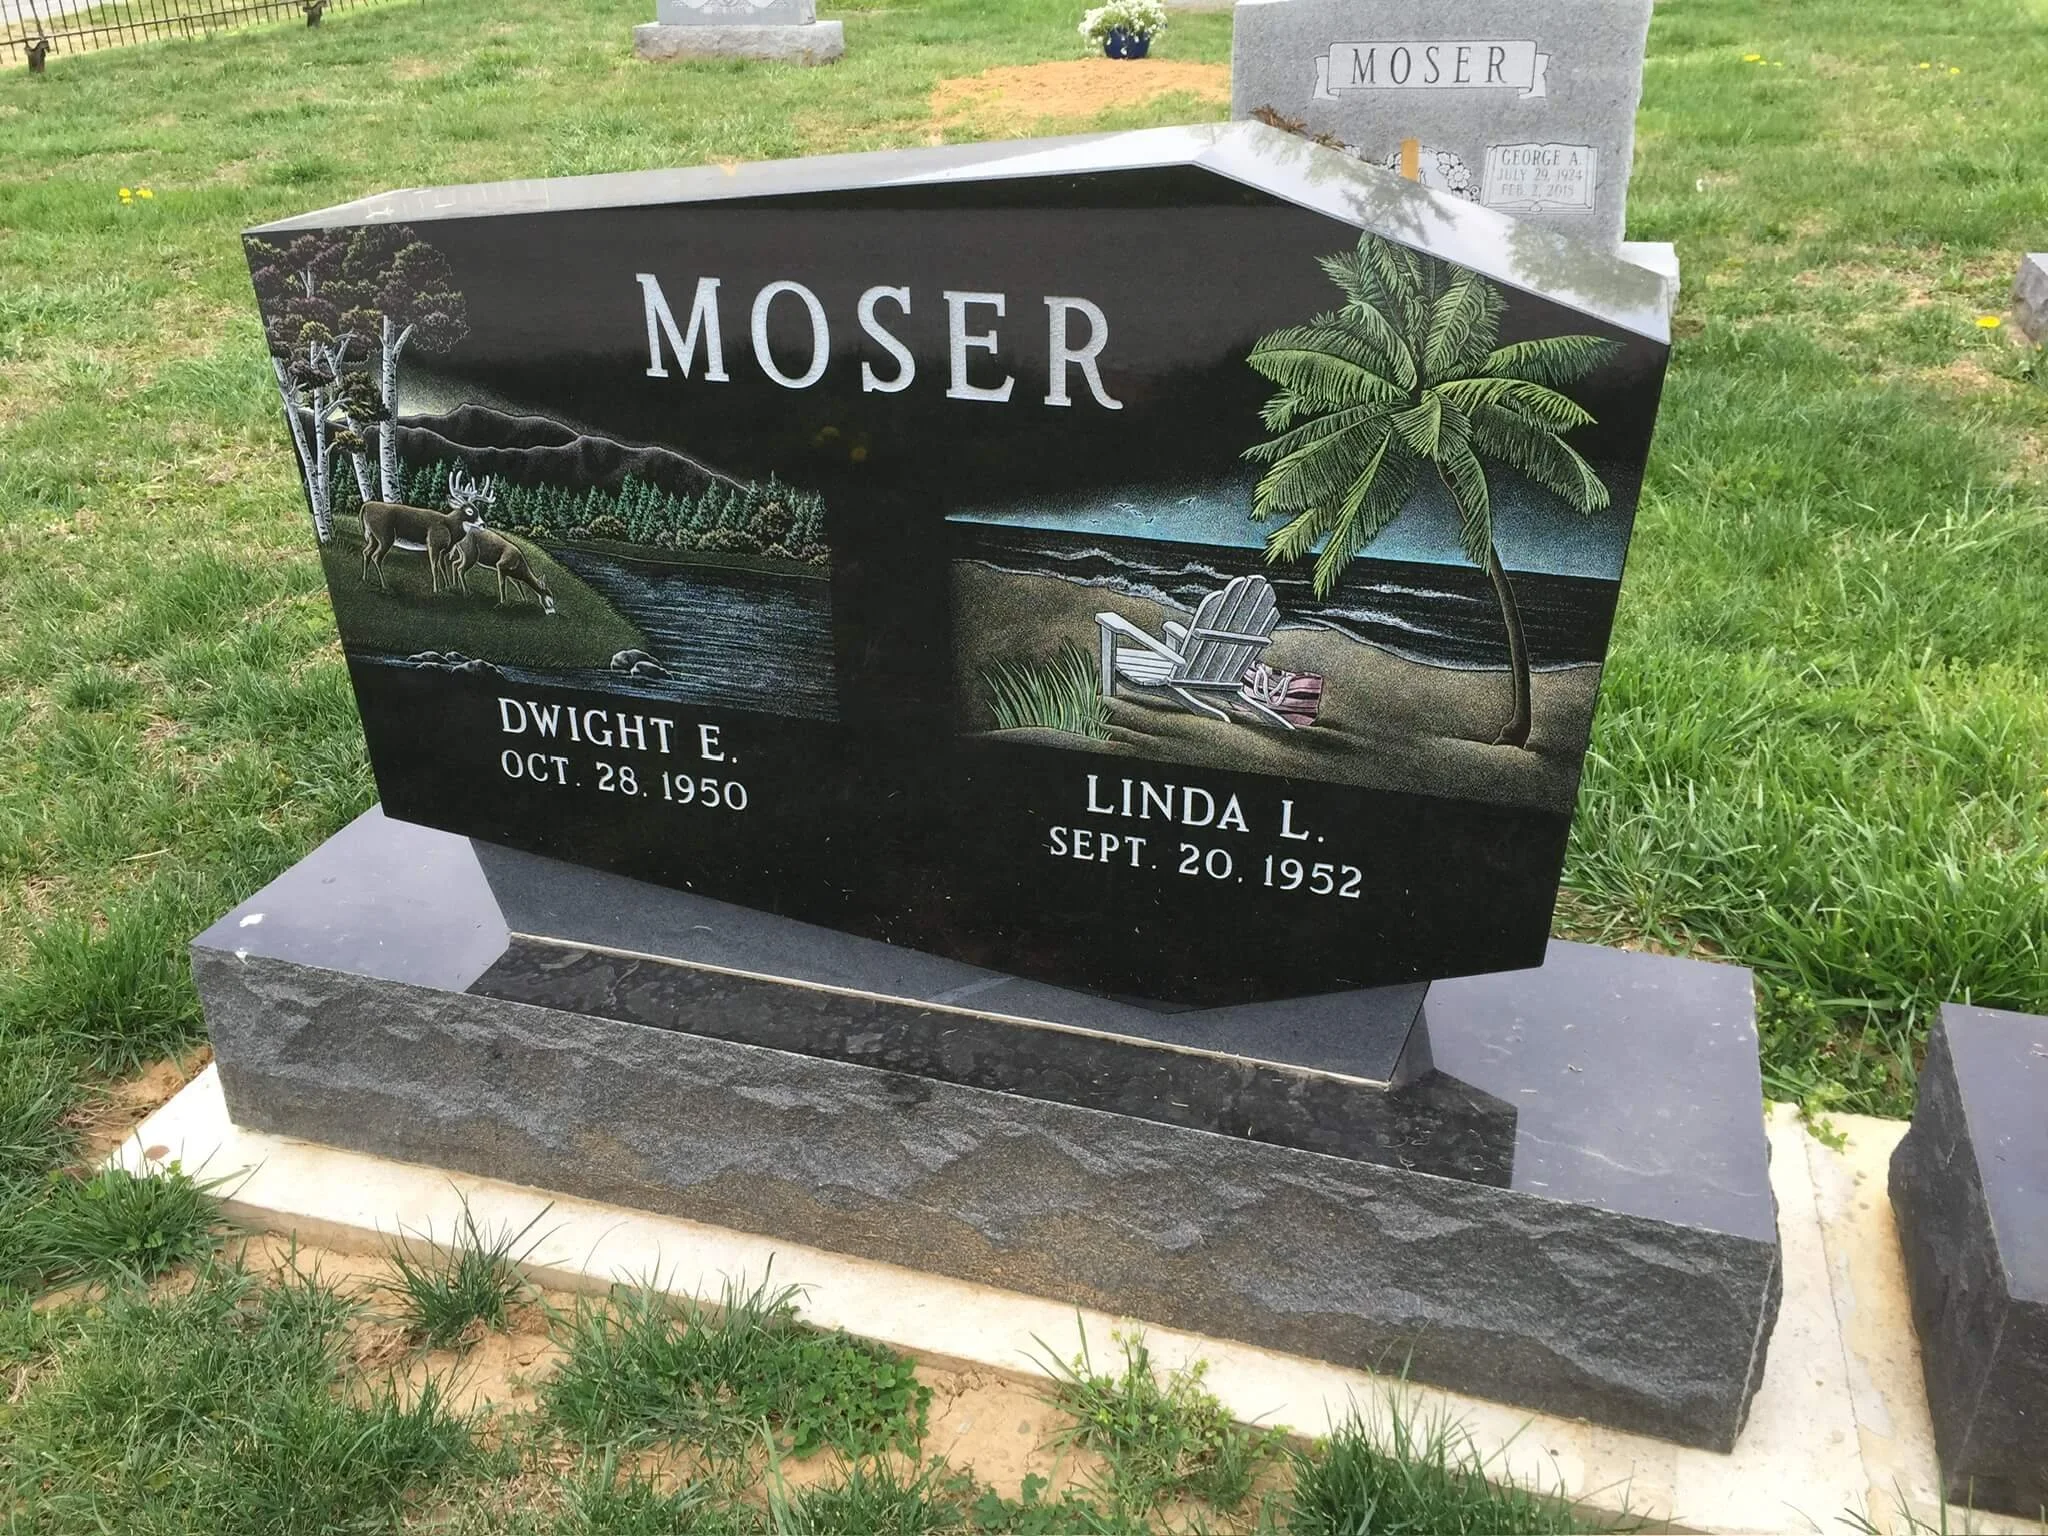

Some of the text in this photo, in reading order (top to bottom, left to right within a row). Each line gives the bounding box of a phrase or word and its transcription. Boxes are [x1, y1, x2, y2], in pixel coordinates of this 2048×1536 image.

[1351, 45, 1507, 84] MOSER
[1497, 167, 1527, 182] JULY
[1501, 148, 1561, 167] GEORGE
[635, 272, 1124, 410] MOSER
[498, 697, 738, 764] DWIGHT E.
[501, 749, 581, 787] OCT.
[661, 771, 749, 811] 1950
[1086, 774, 1325, 844] LINDA L.
[1049, 826, 1158, 870] SEPT.
[1263, 854, 1363, 899] 1952
